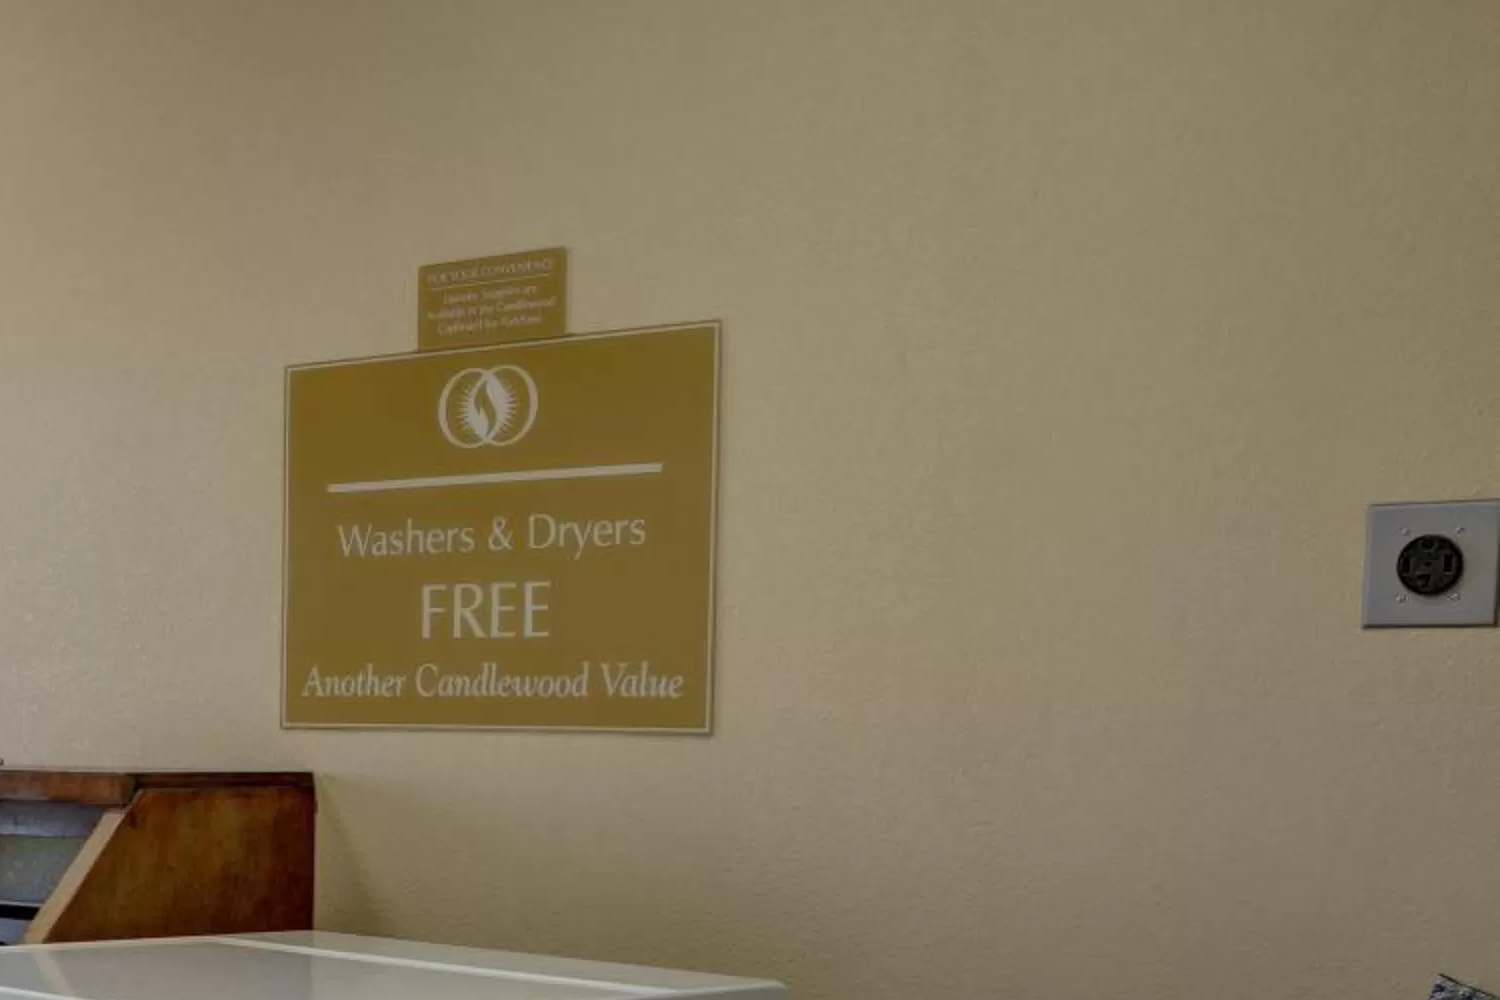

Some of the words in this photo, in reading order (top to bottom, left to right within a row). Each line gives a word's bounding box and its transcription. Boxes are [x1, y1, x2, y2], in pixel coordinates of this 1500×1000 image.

[337, 517, 476, 558] Washers
[488, 515, 514, 551] &
[528, 512, 646, 561] Dryers
[421, 580, 552, 640] FREE
[302, 663, 406, 698] Another
[415, 661, 589, 699] Candlewood
[600, 661, 685, 699] Value
